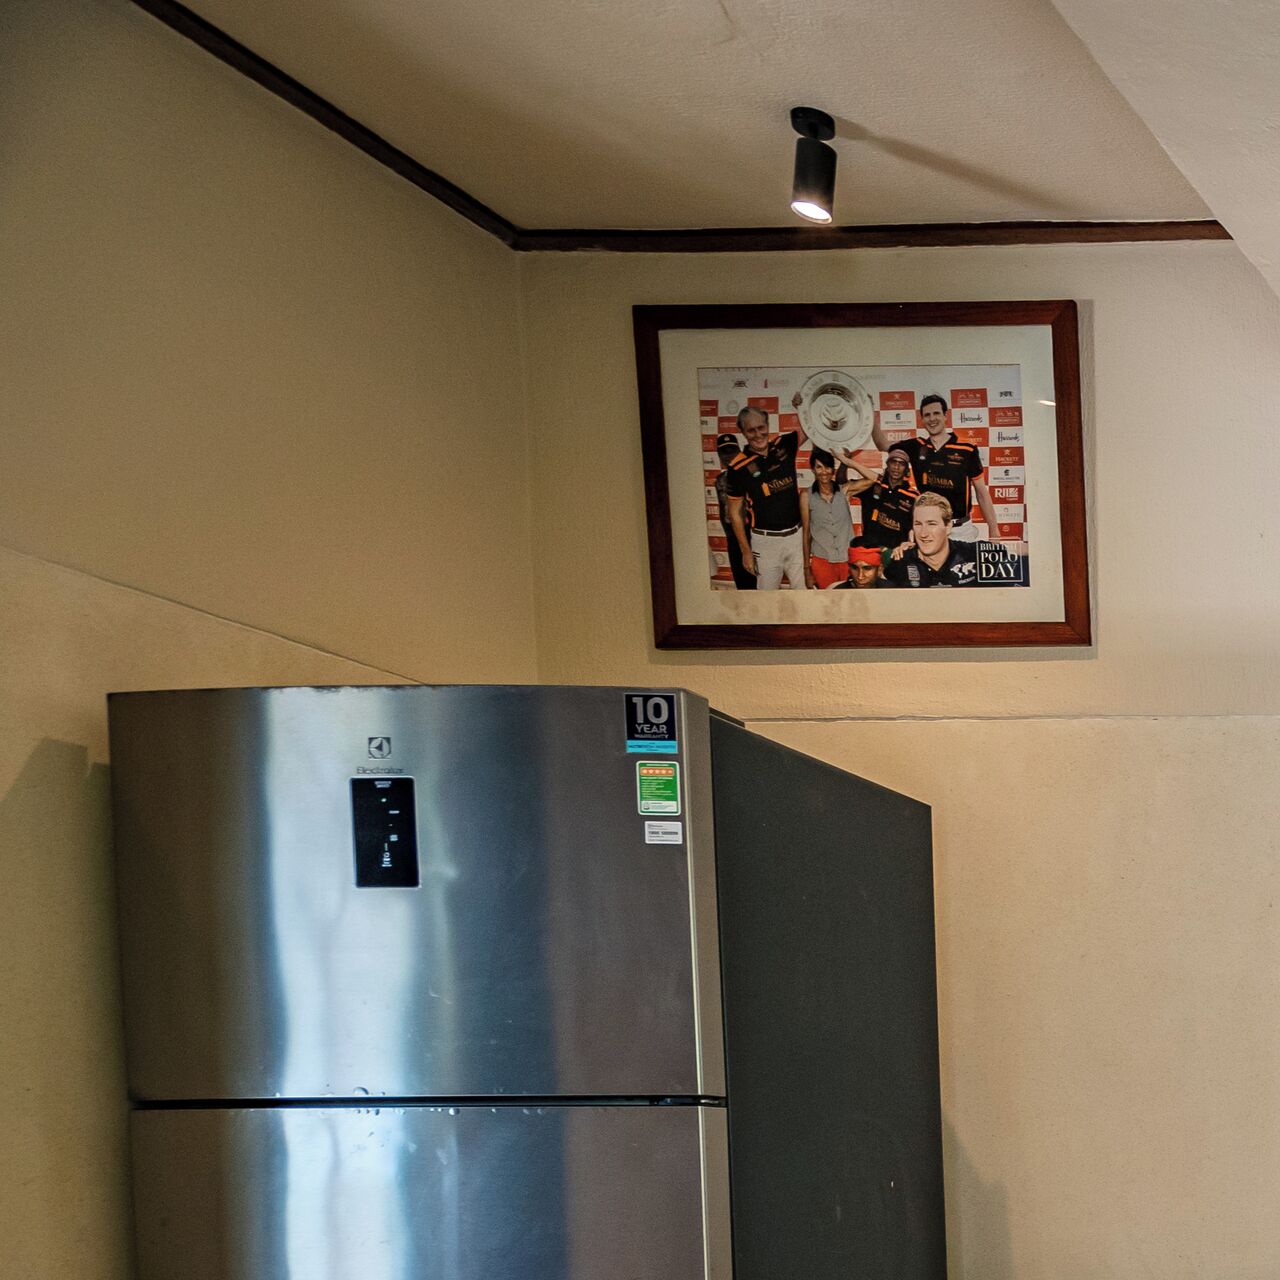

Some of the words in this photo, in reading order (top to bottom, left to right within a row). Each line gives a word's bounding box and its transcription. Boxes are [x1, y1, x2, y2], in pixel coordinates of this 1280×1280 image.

[980, 552, 1018, 563] POLO
[981, 563, 1018, 578] DAY
[632, 696, 669, 724] 10
[635, 724, 668, 734] YEAR
